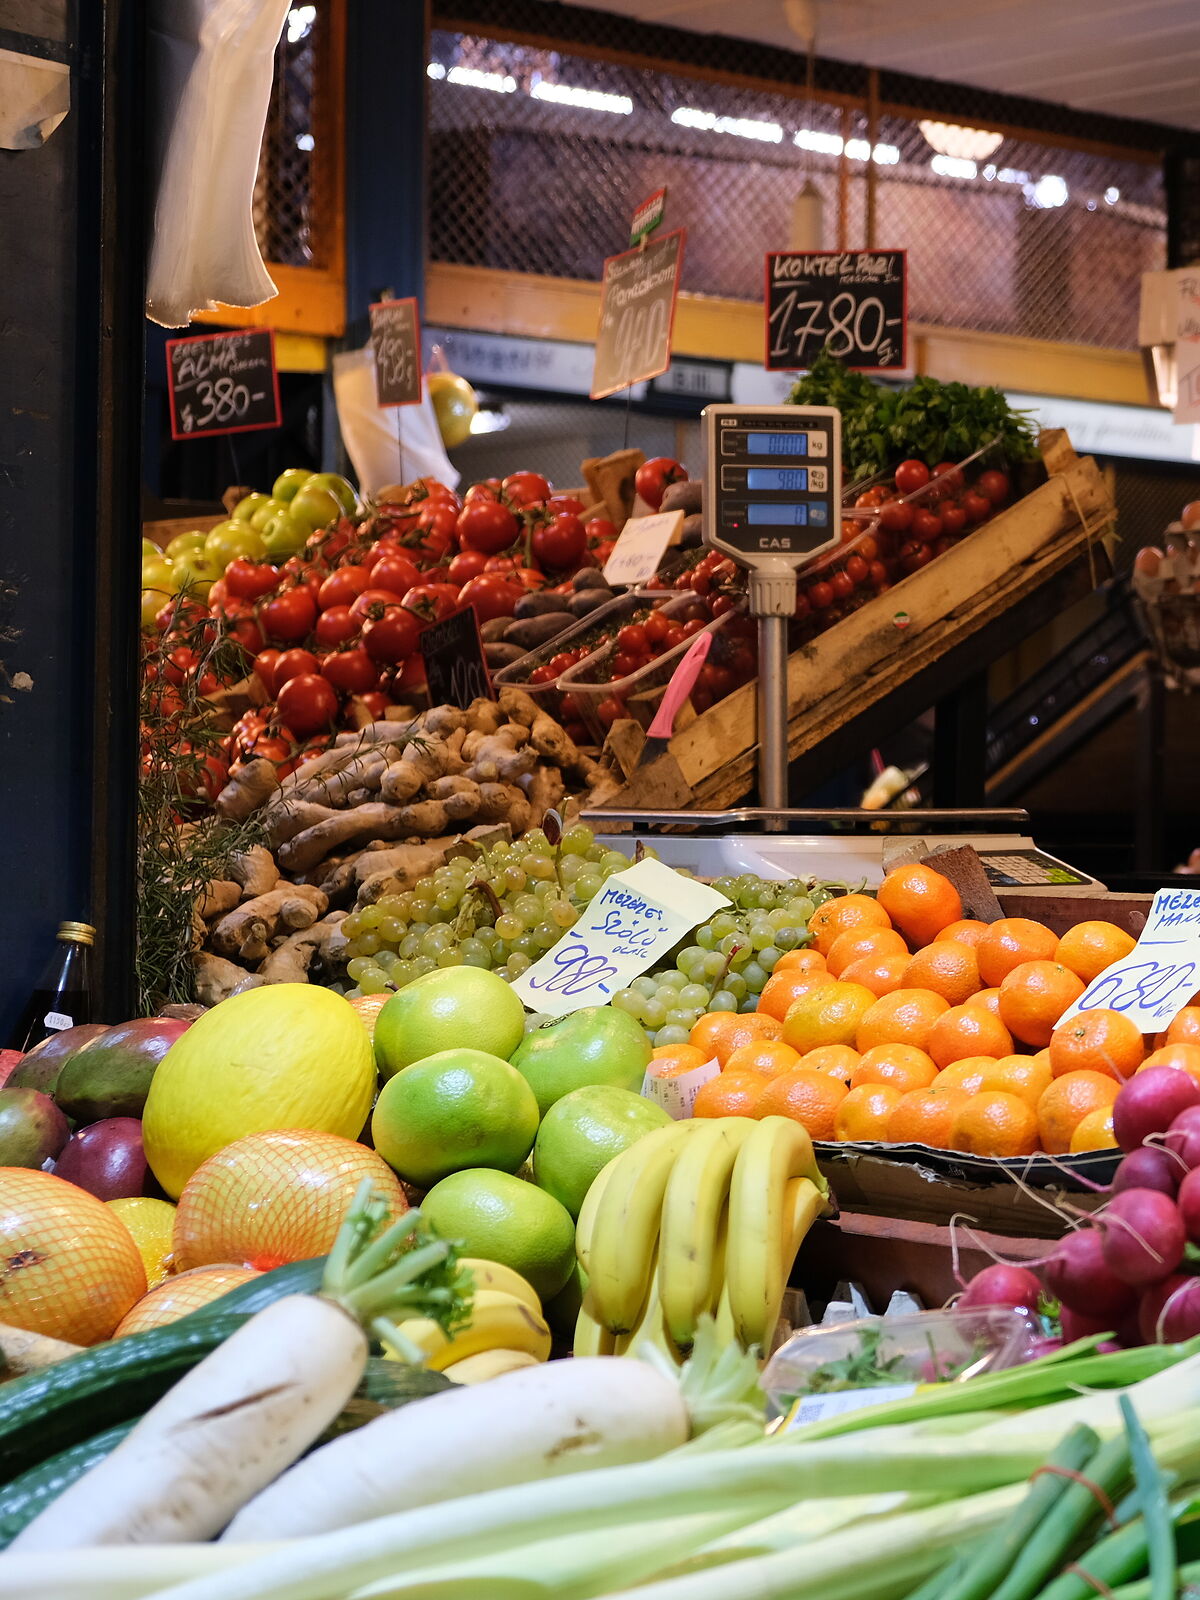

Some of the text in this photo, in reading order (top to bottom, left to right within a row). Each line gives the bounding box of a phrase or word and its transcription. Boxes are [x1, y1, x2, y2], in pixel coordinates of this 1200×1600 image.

[811, 441, 824, 451] kg
[778, 470, 803, 490] 980
[759, 538, 791, 548] CAS
